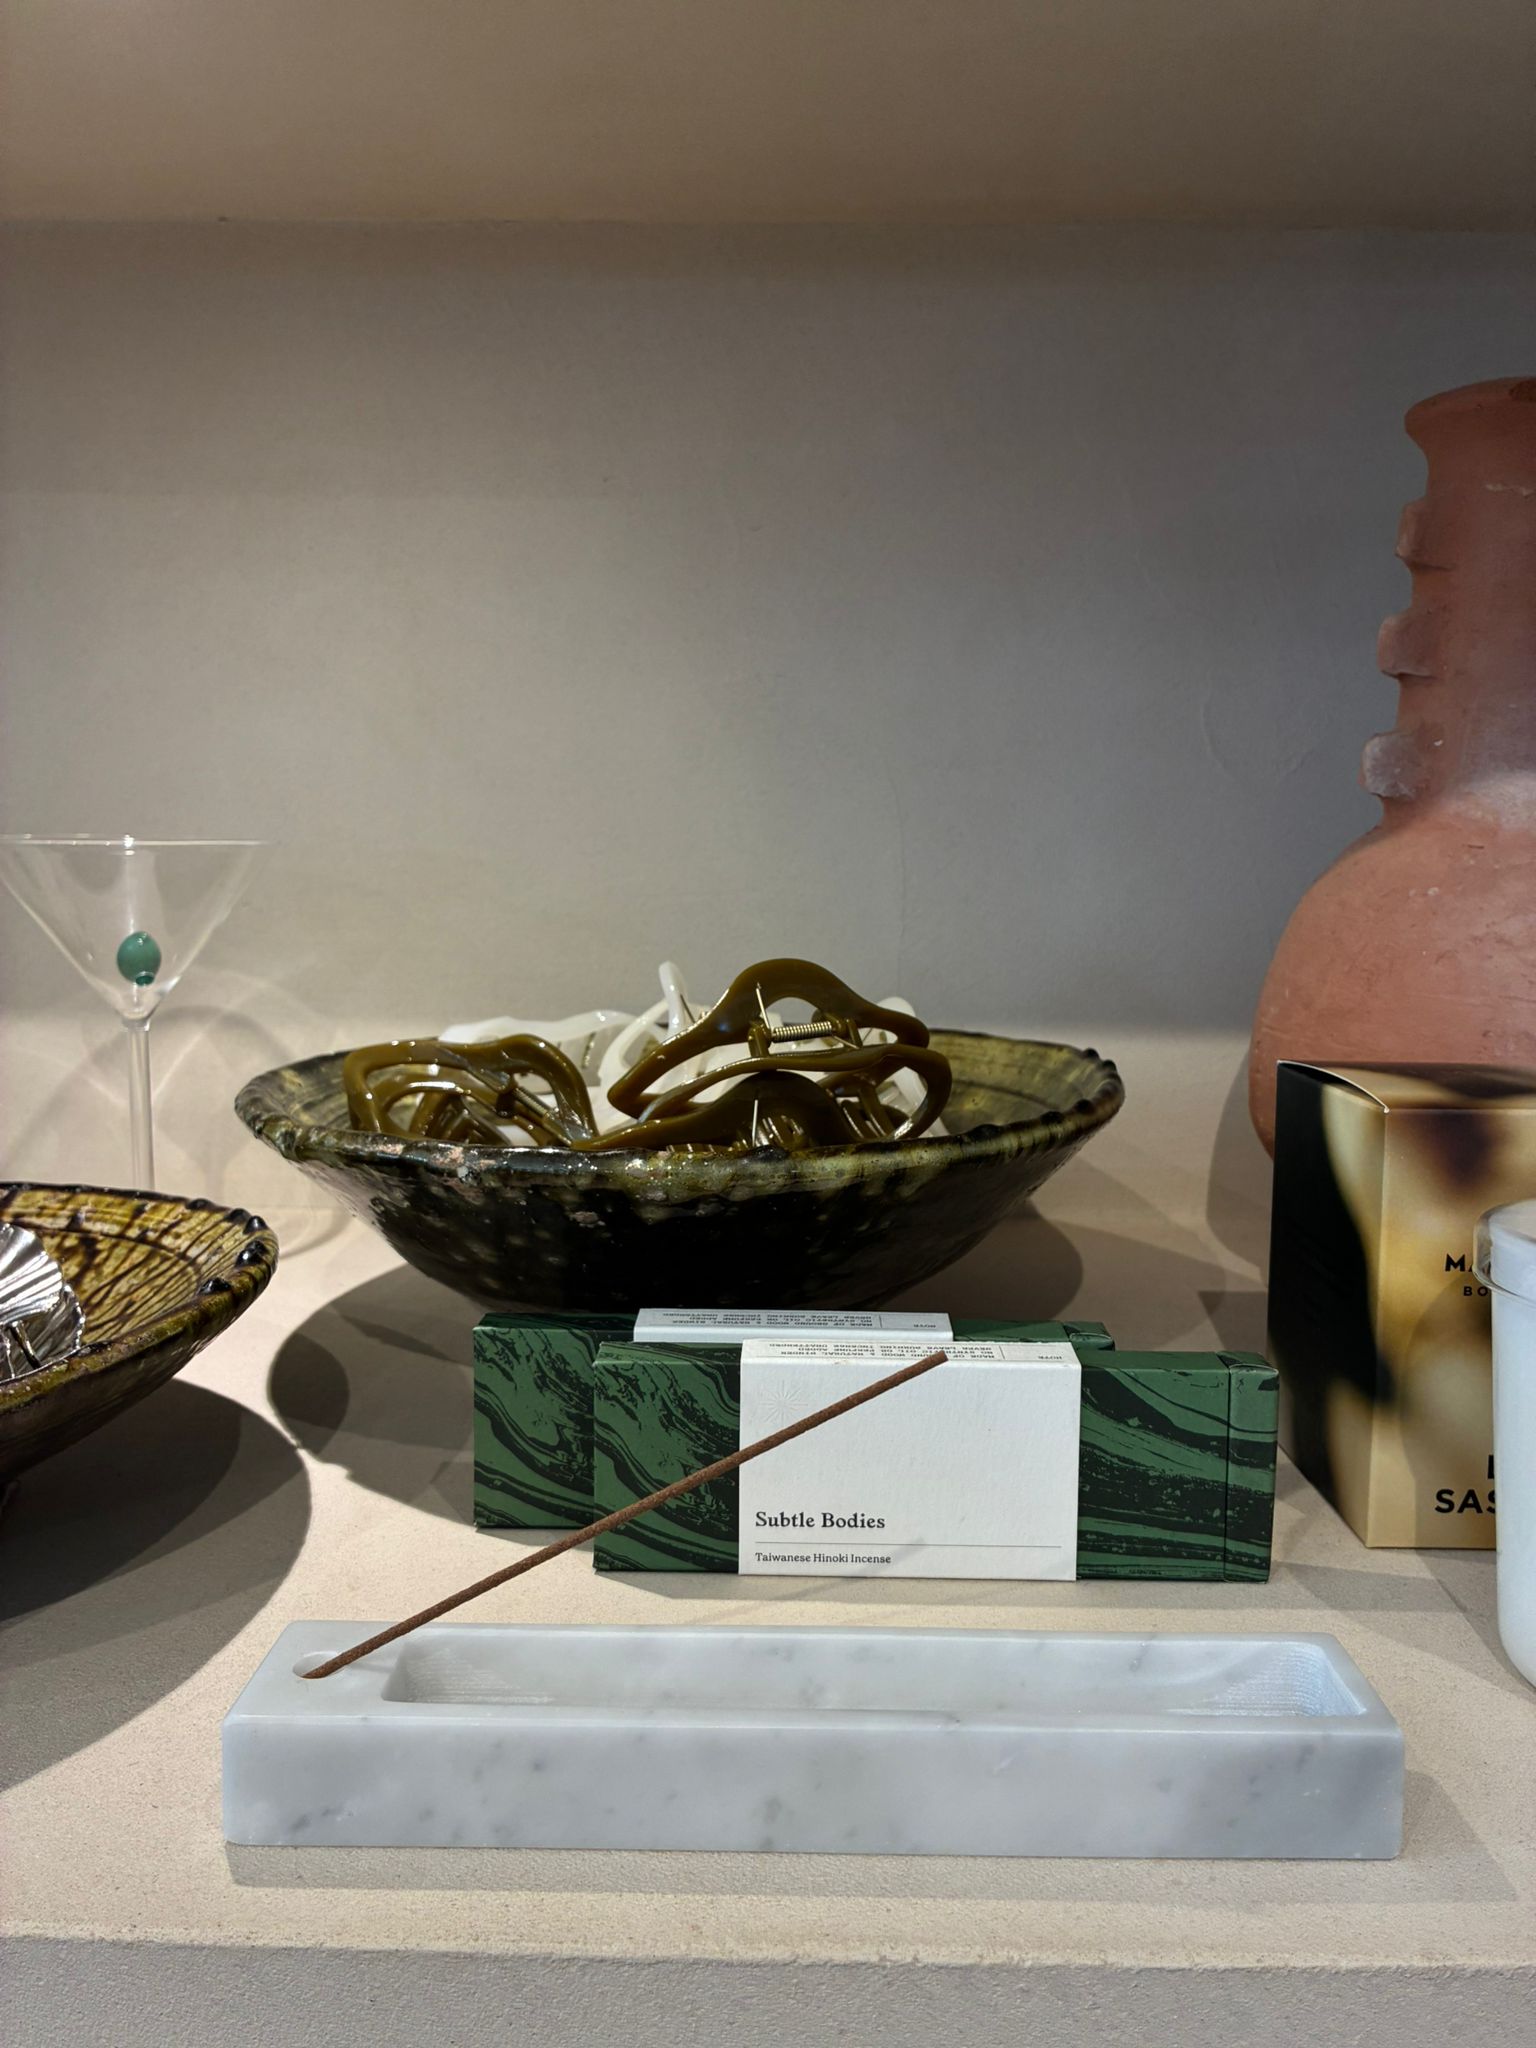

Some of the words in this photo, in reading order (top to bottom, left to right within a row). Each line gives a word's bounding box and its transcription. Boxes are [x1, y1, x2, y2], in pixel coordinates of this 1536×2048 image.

[755, 1511, 815, 1528] Subtle
[821, 1512, 885, 1529] Bodies
[755, 1552, 811, 1562] Taiwanese
[813, 1553, 849, 1563] Hinoki
[851, 1554, 892, 1563] Incense
